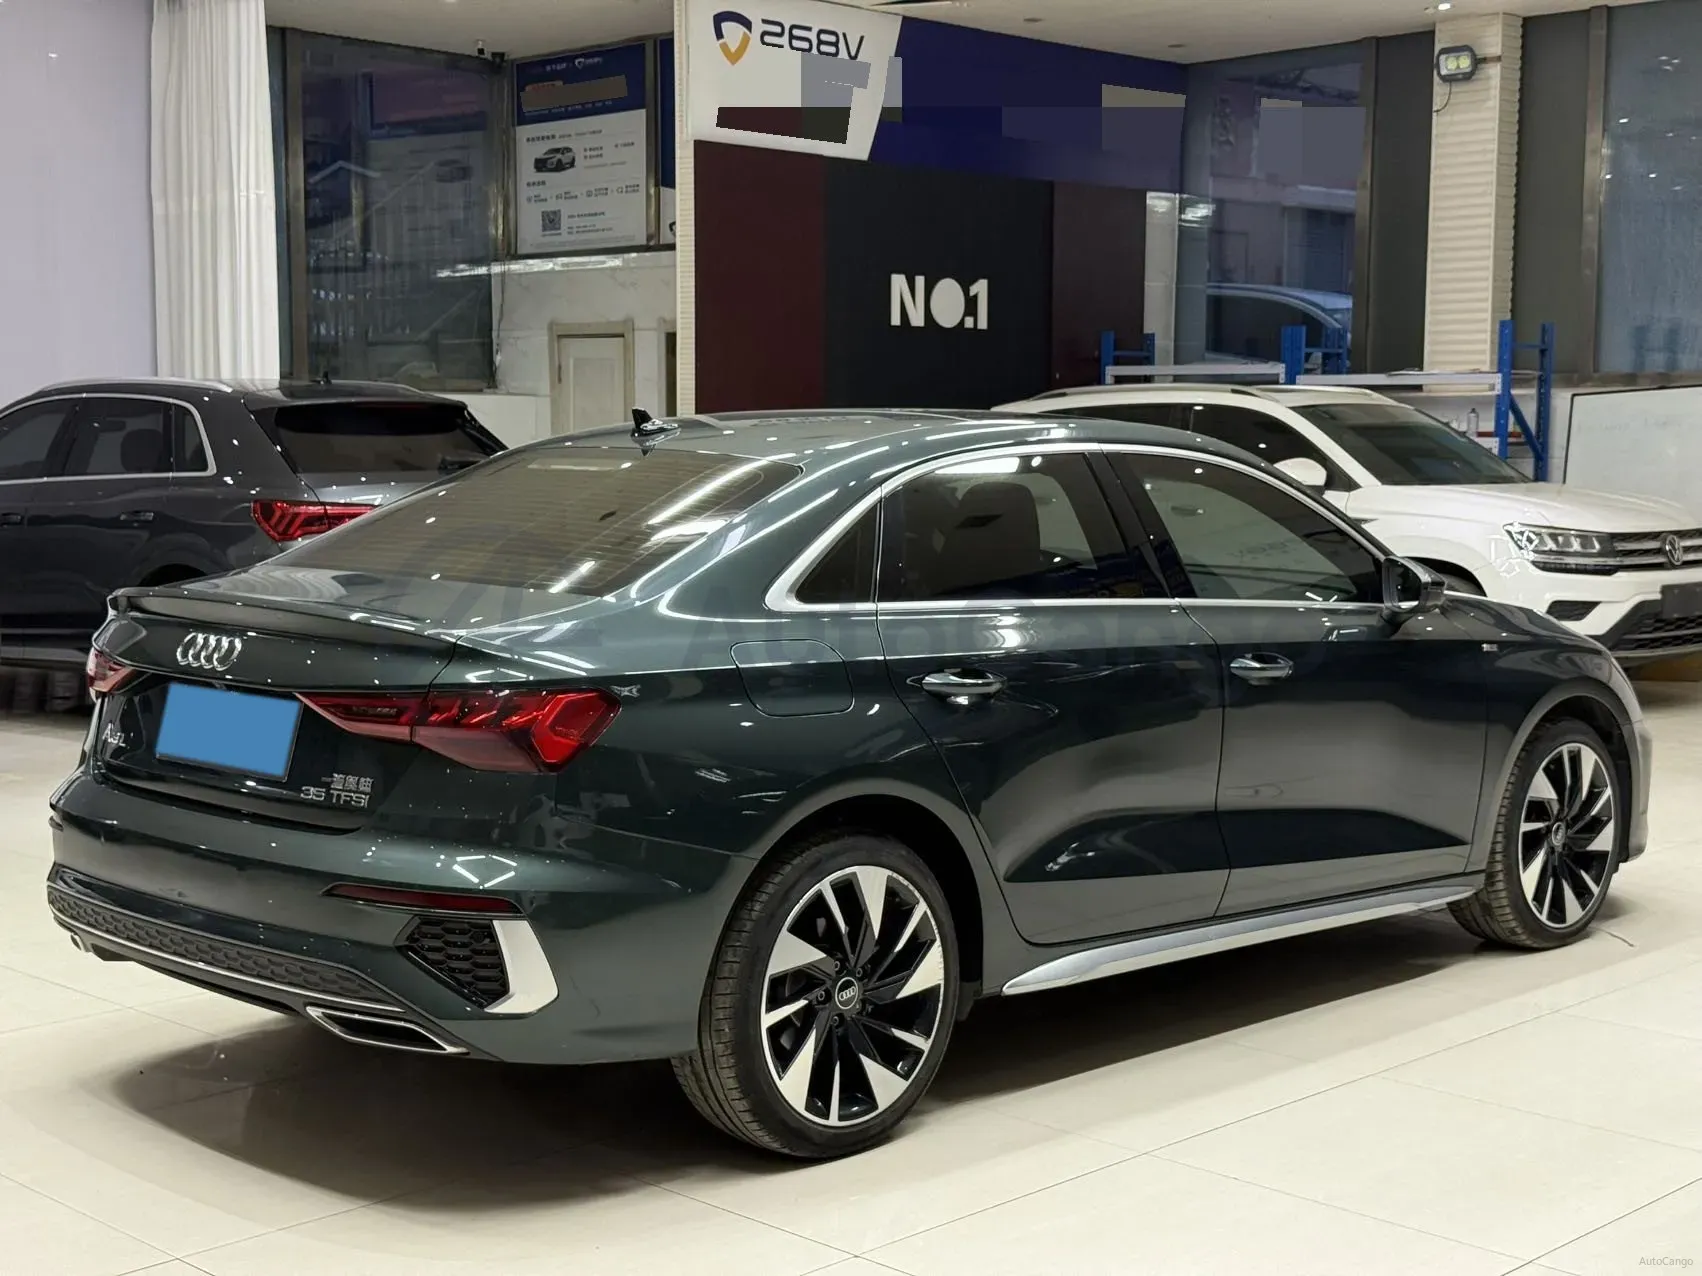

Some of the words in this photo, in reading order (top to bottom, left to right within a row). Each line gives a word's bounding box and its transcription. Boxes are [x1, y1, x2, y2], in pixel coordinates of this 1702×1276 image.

[760, 18, 865, 60] 268V
[890, 273, 988, 330] NO.1
[300, 785, 326, 801] 35
[329, 789, 370, 808] TFSI
